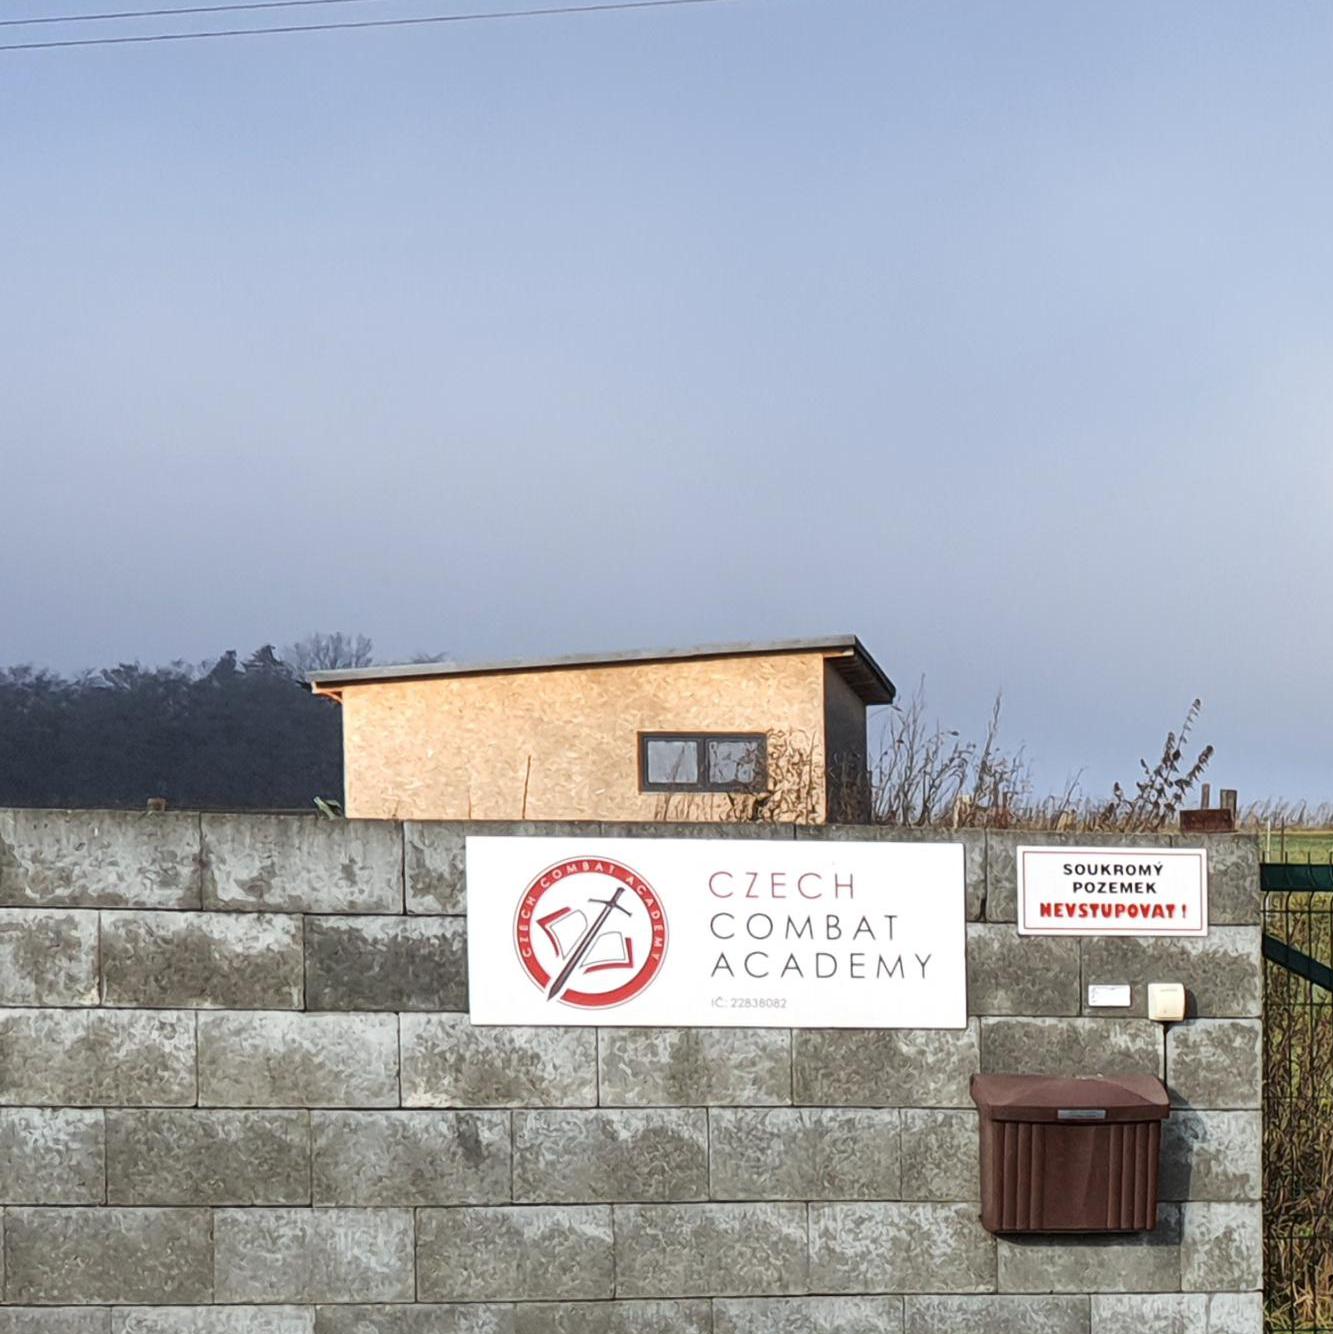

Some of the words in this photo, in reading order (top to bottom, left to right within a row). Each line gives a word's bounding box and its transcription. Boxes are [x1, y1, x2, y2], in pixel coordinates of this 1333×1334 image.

[1063, 861, 1164, 876] SOUKROMÝ
[708, 871, 854, 899] CZECH
[1073, 882, 1157, 894] POZEMEK
[519, 896, 537, 958] CZECH
[540, 861, 615, 889] COMBAT
[626, 876, 664, 961] ACADEMY
[710, 912, 898, 940] COMBAT
[711, 951, 932, 979] ACADEMY
